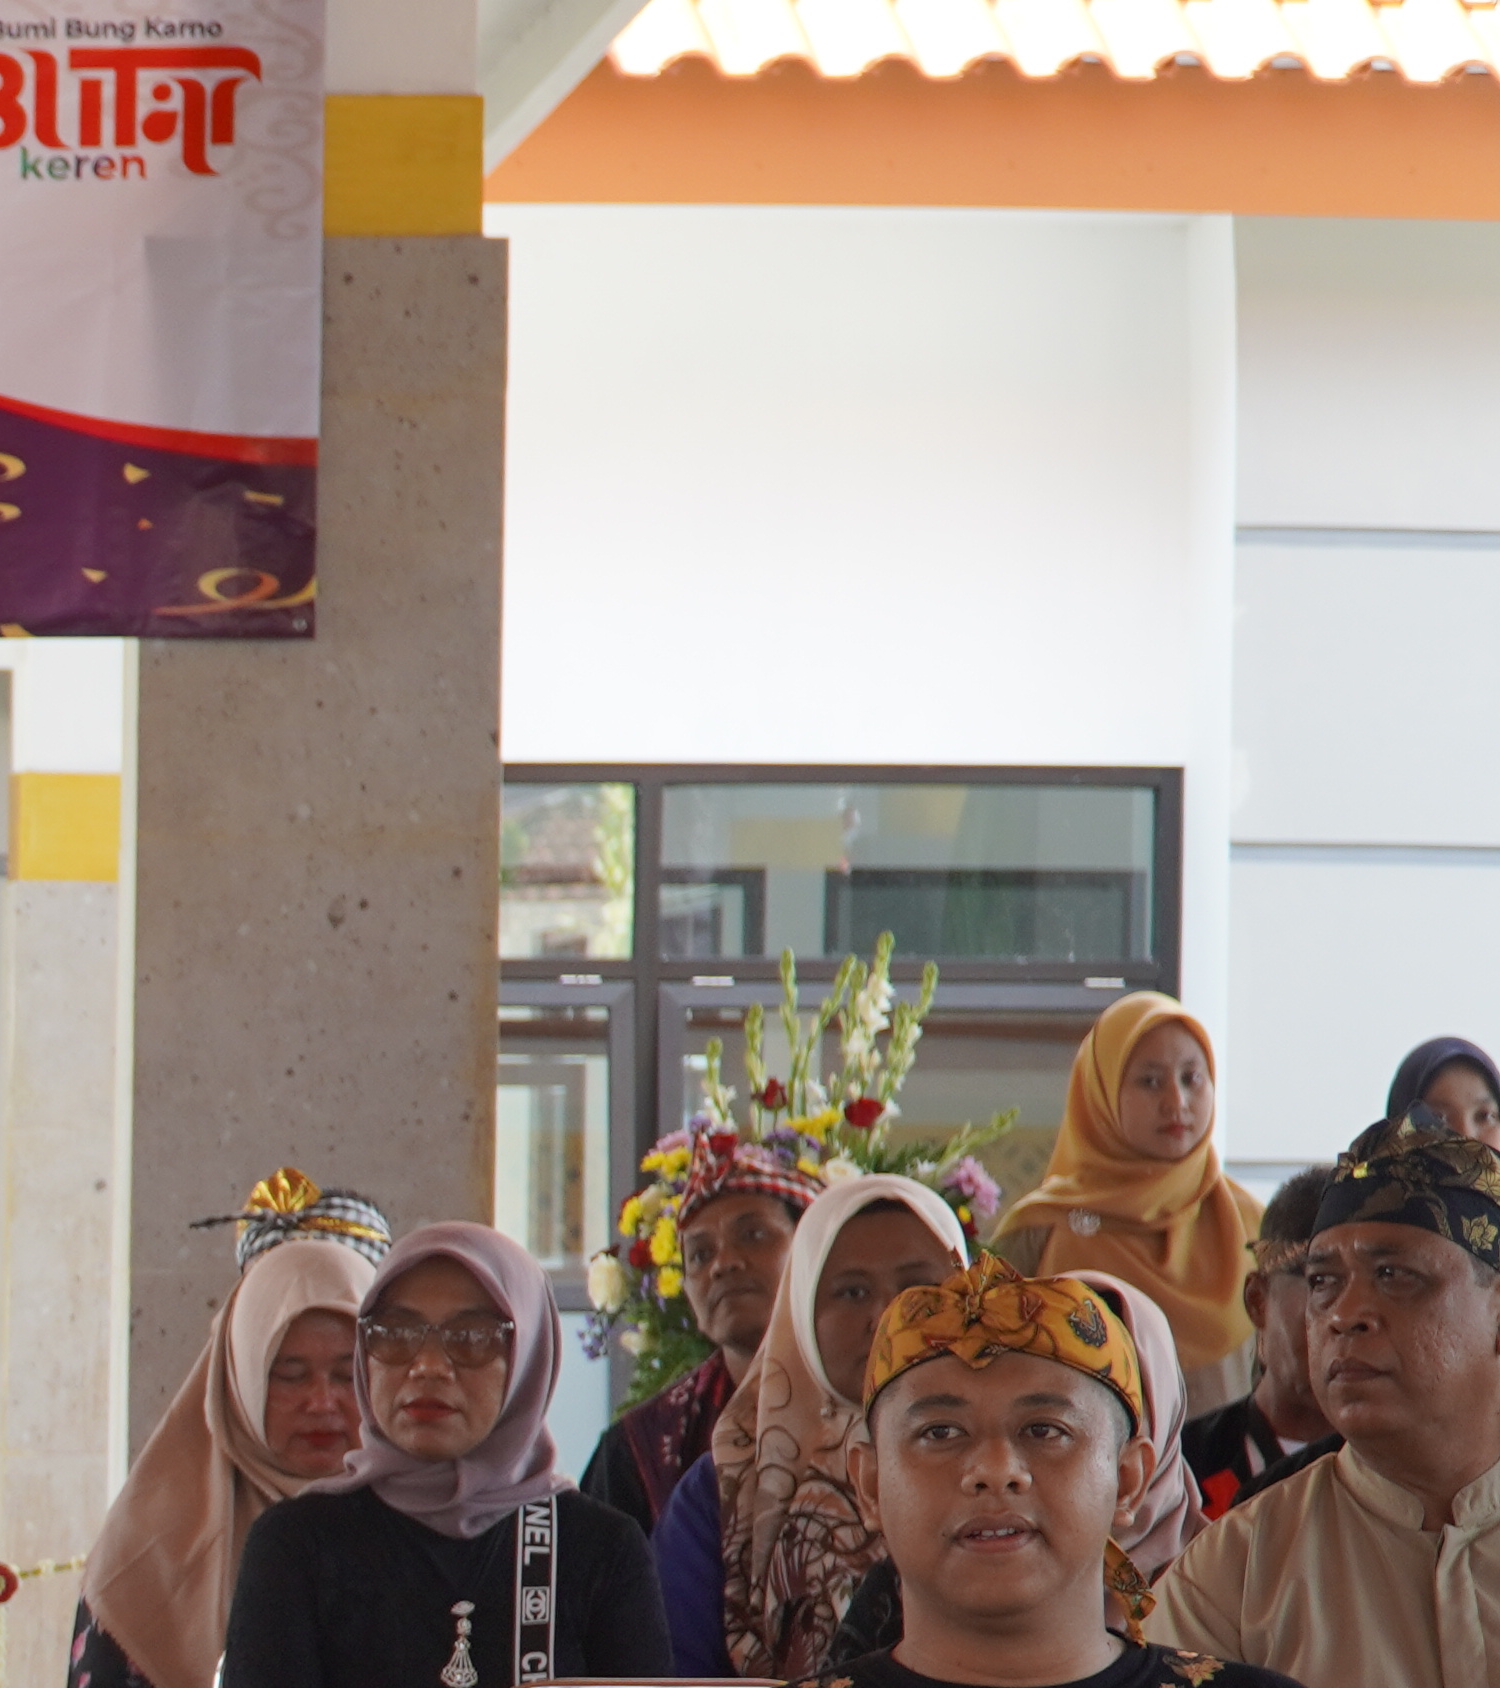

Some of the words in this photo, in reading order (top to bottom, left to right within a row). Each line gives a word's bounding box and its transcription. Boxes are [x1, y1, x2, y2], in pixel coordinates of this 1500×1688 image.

[65, 18, 135, 43] Bung
[145, 16, 223, 40] Karno
[20, 147, 148, 181] keren
